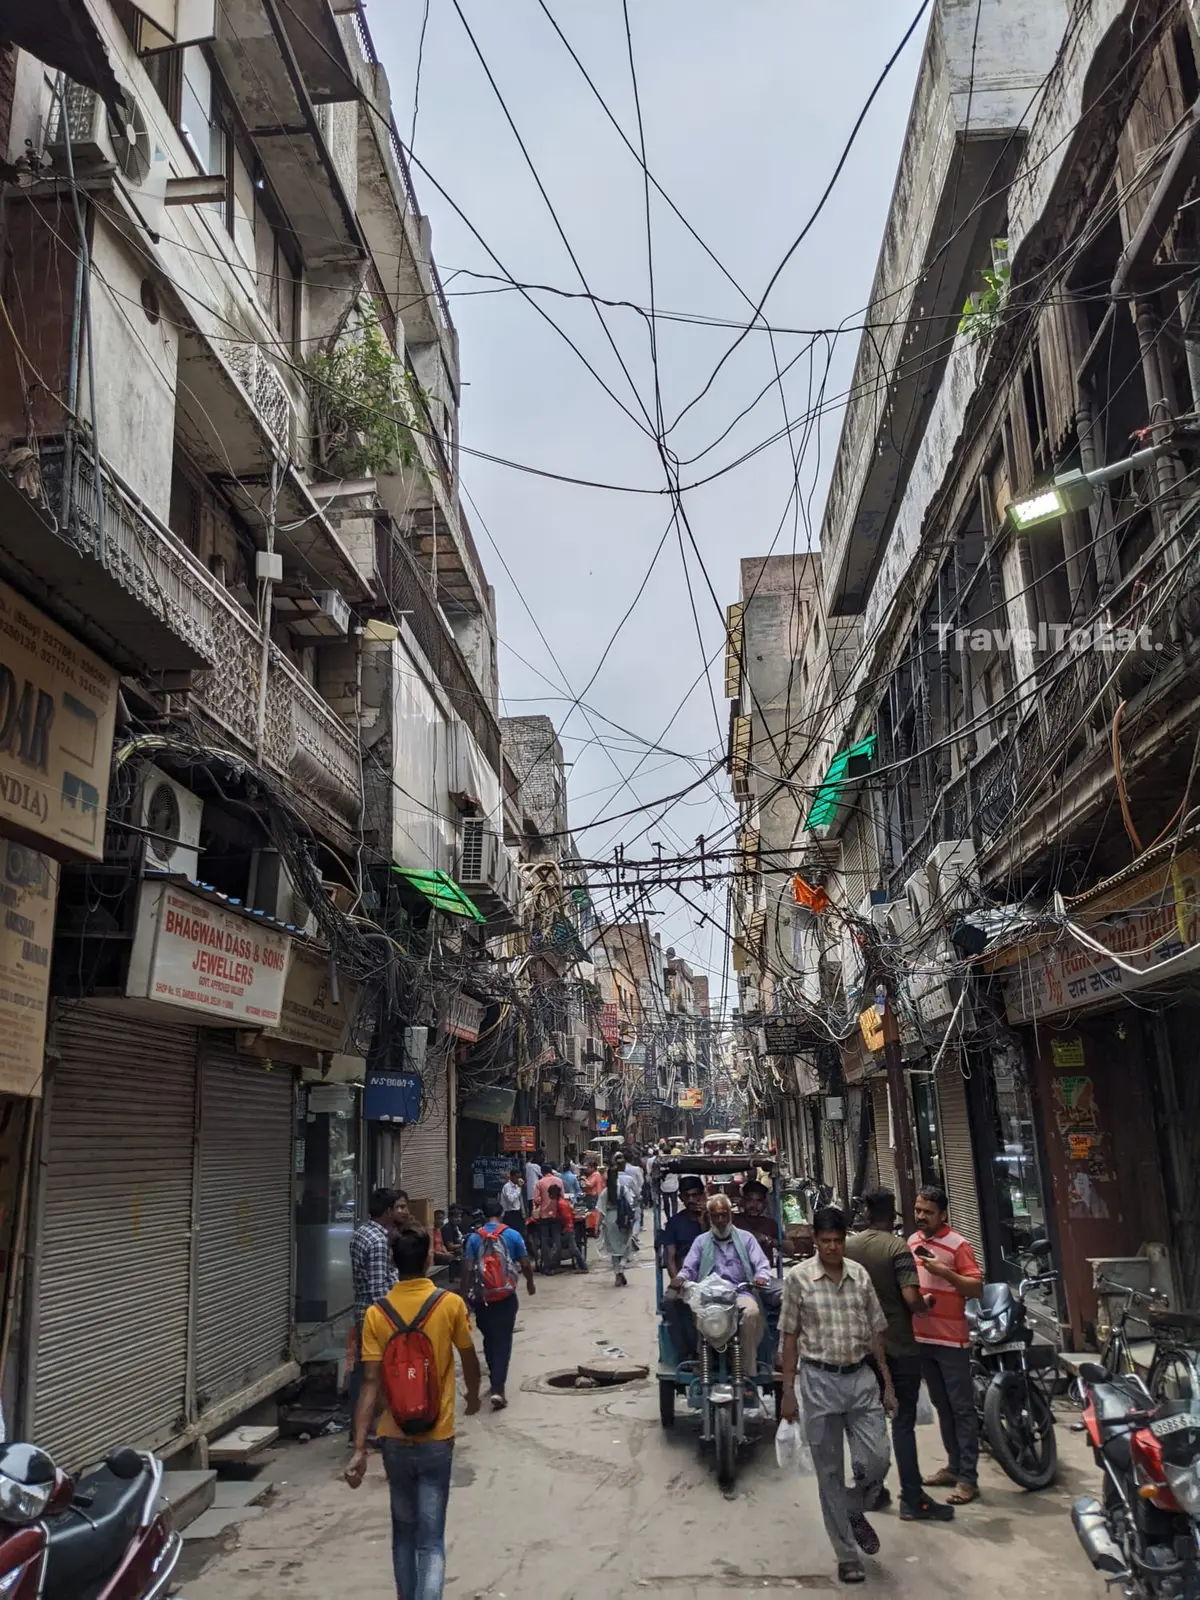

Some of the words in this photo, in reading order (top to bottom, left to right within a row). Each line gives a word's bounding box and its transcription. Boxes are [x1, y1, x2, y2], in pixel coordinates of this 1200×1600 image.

[165, 910, 224, 950] BHAGWAN
[225, 933, 252, 961] DASS
[253, 944, 260, 963] &
[262, 948, 285, 972] SONS
[192, 949, 254, 986] JEWELLERS
